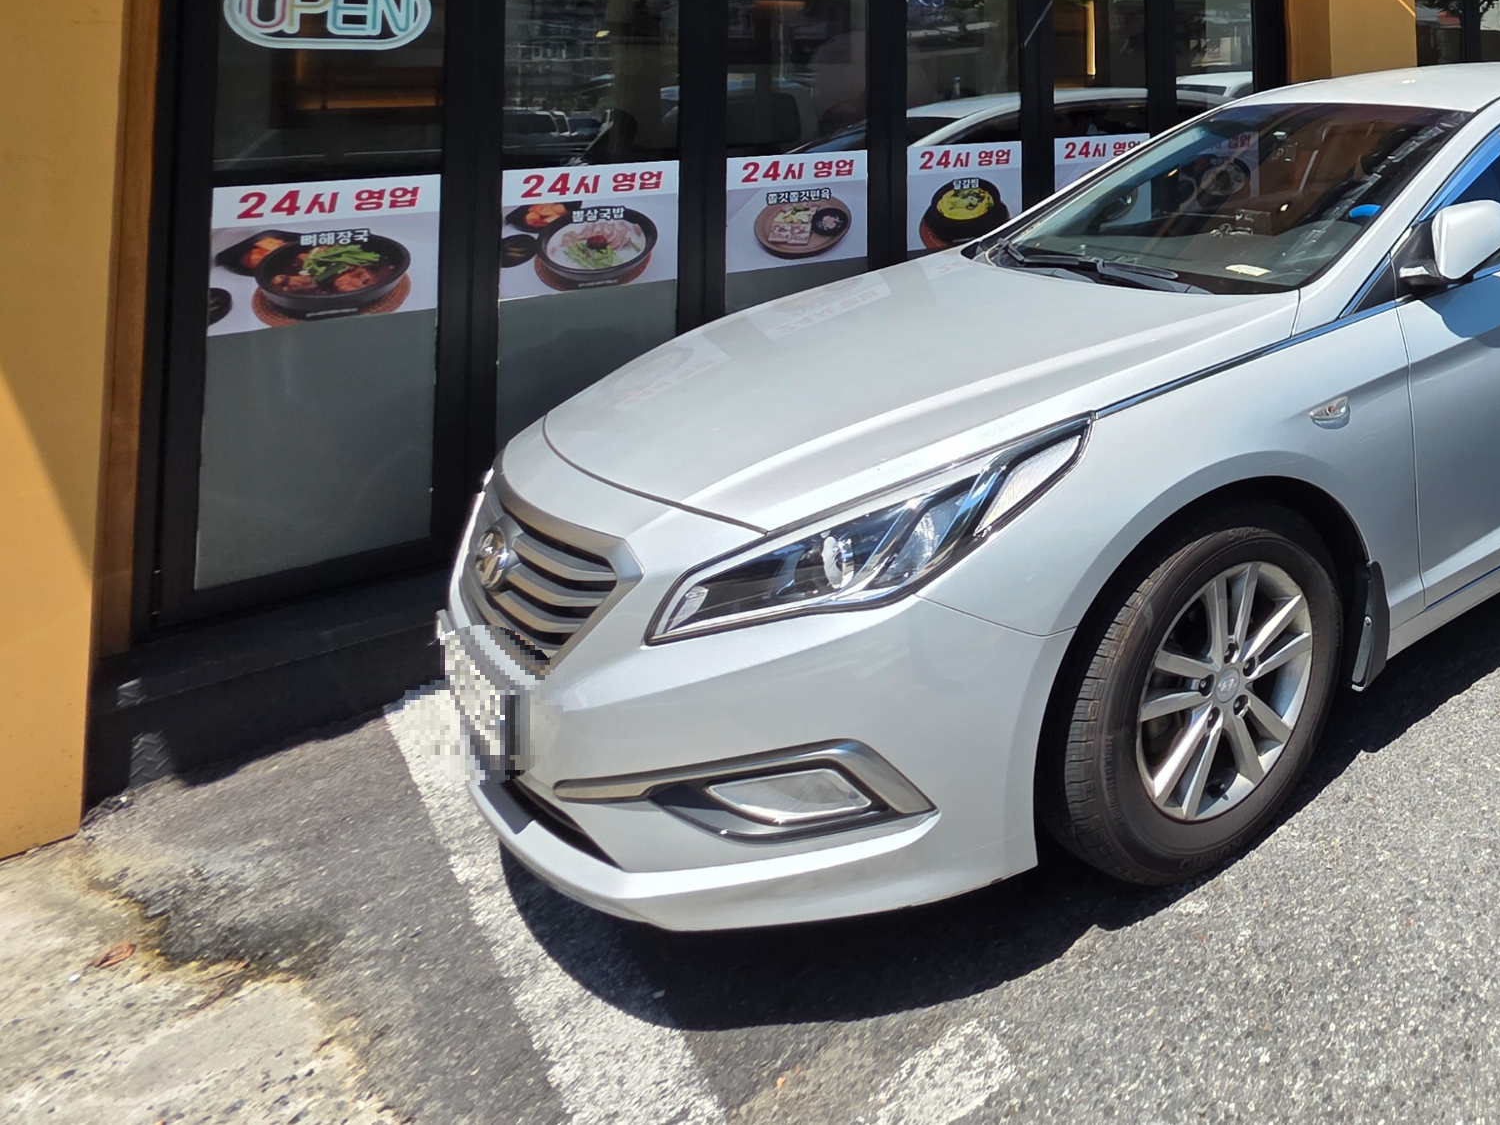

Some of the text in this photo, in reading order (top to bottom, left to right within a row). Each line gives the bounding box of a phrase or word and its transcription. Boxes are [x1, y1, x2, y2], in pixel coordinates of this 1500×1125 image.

[919, 149, 1012, 170] 24시 영업
[1064, 141, 1107, 160] 24시
[741, 159, 855, 183] 24시 영업
[521, 171, 664, 198] 24시 영업
[236, 186, 421, 219] 24시 영업
